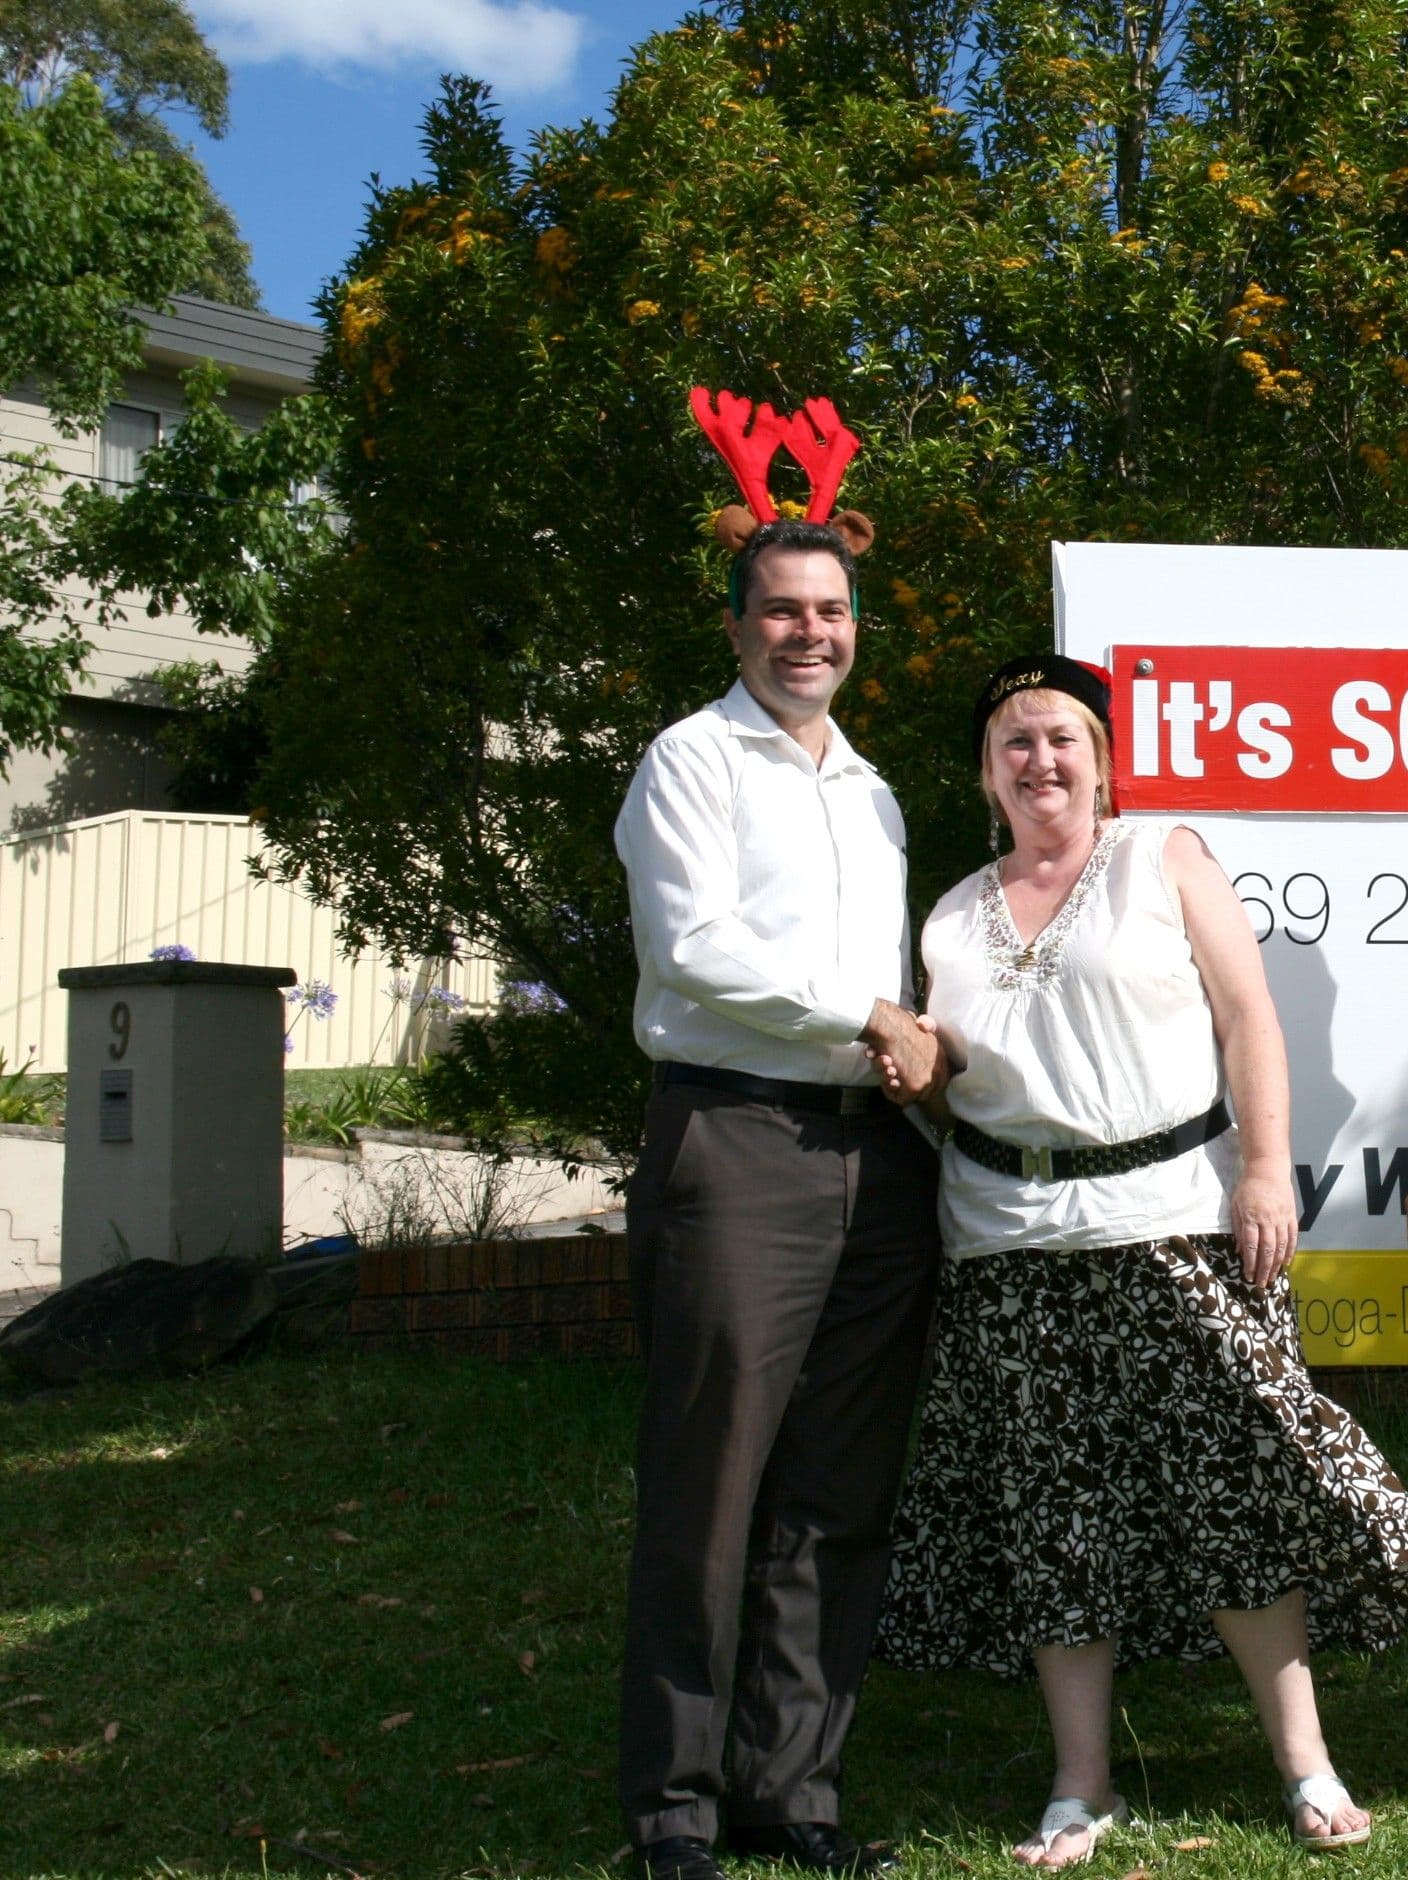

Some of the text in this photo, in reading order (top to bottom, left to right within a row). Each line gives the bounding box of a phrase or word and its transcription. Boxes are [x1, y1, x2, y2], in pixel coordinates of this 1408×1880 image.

[991, 670, 1045, 701] Sexy
[1132, 679, 1294, 779] It's
[109, 1001, 131, 1061] 9
